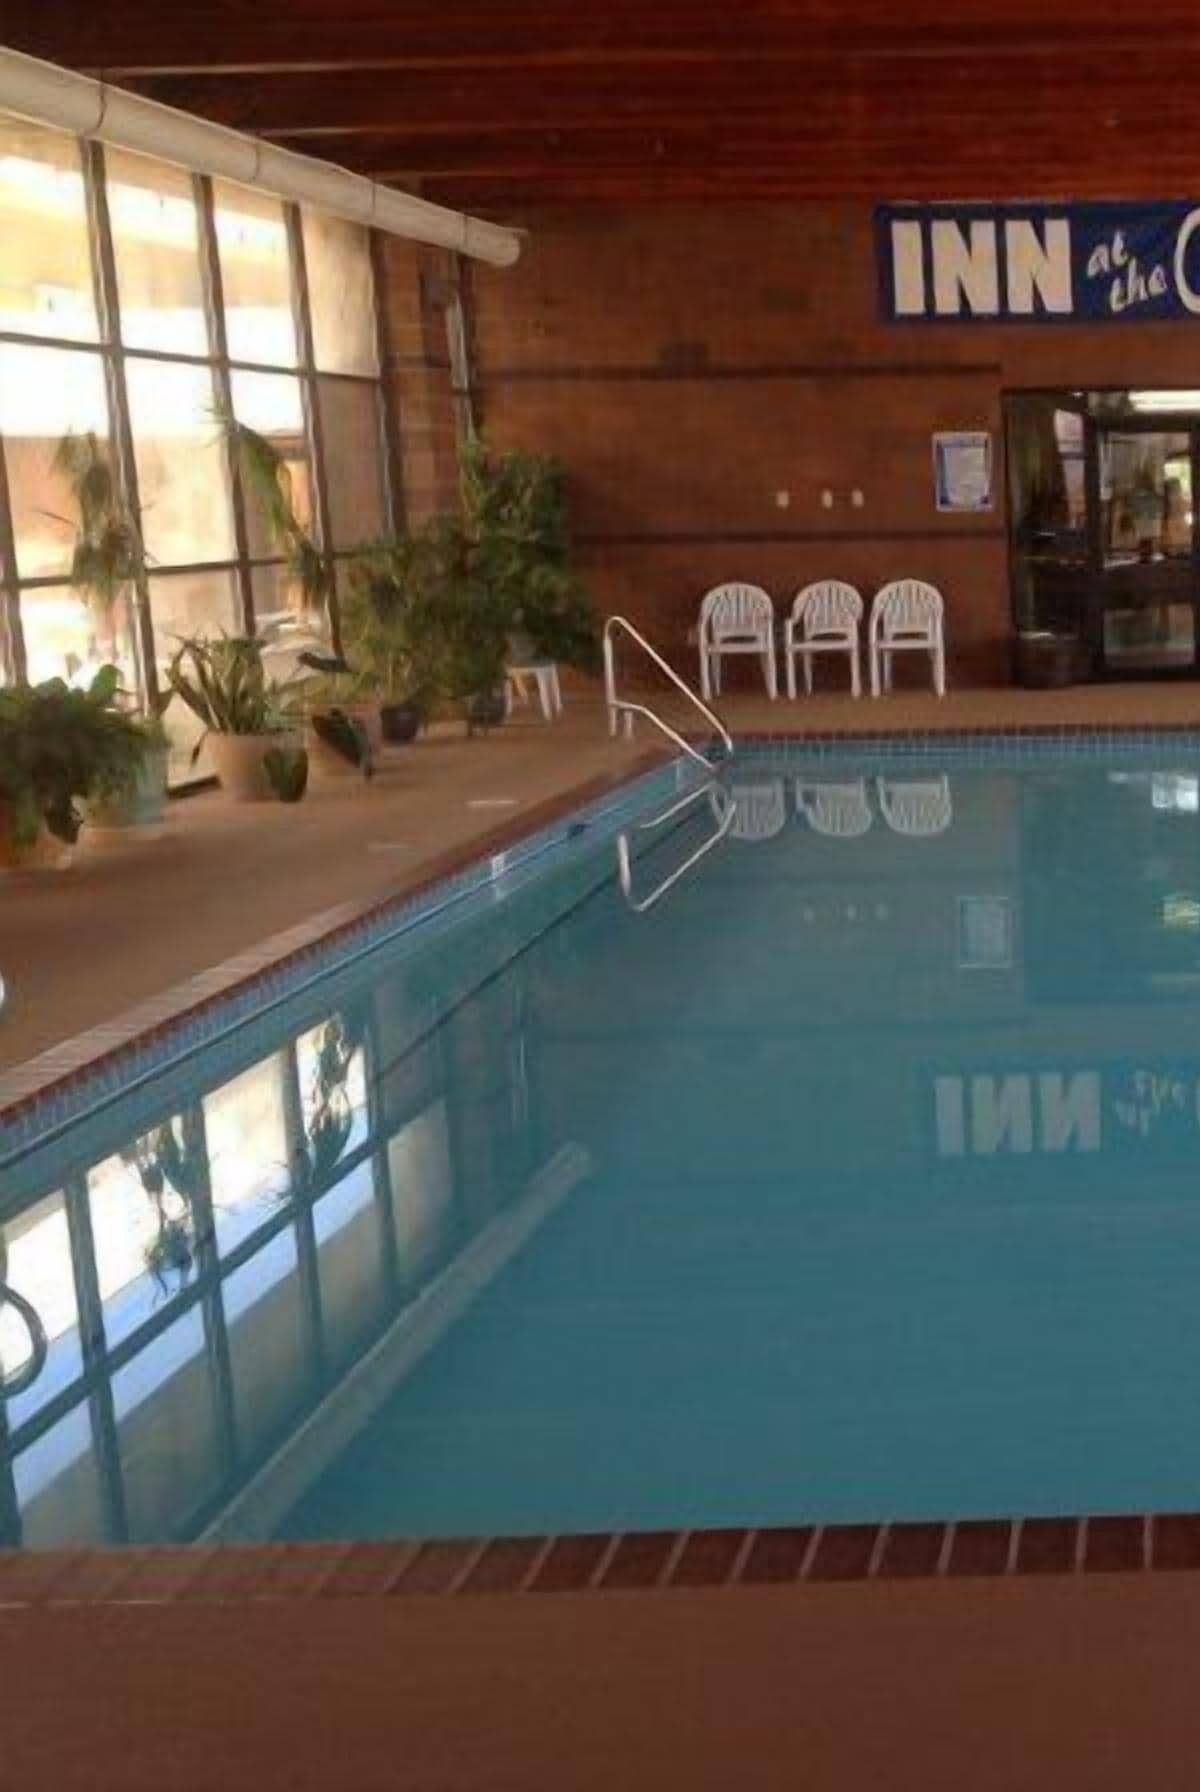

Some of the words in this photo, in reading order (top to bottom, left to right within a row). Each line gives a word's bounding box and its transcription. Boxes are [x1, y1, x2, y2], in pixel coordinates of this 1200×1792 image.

[891, 218, 1073, 315] INN
[1086, 229, 1129, 278] at
[1110, 256, 1168, 313] the
